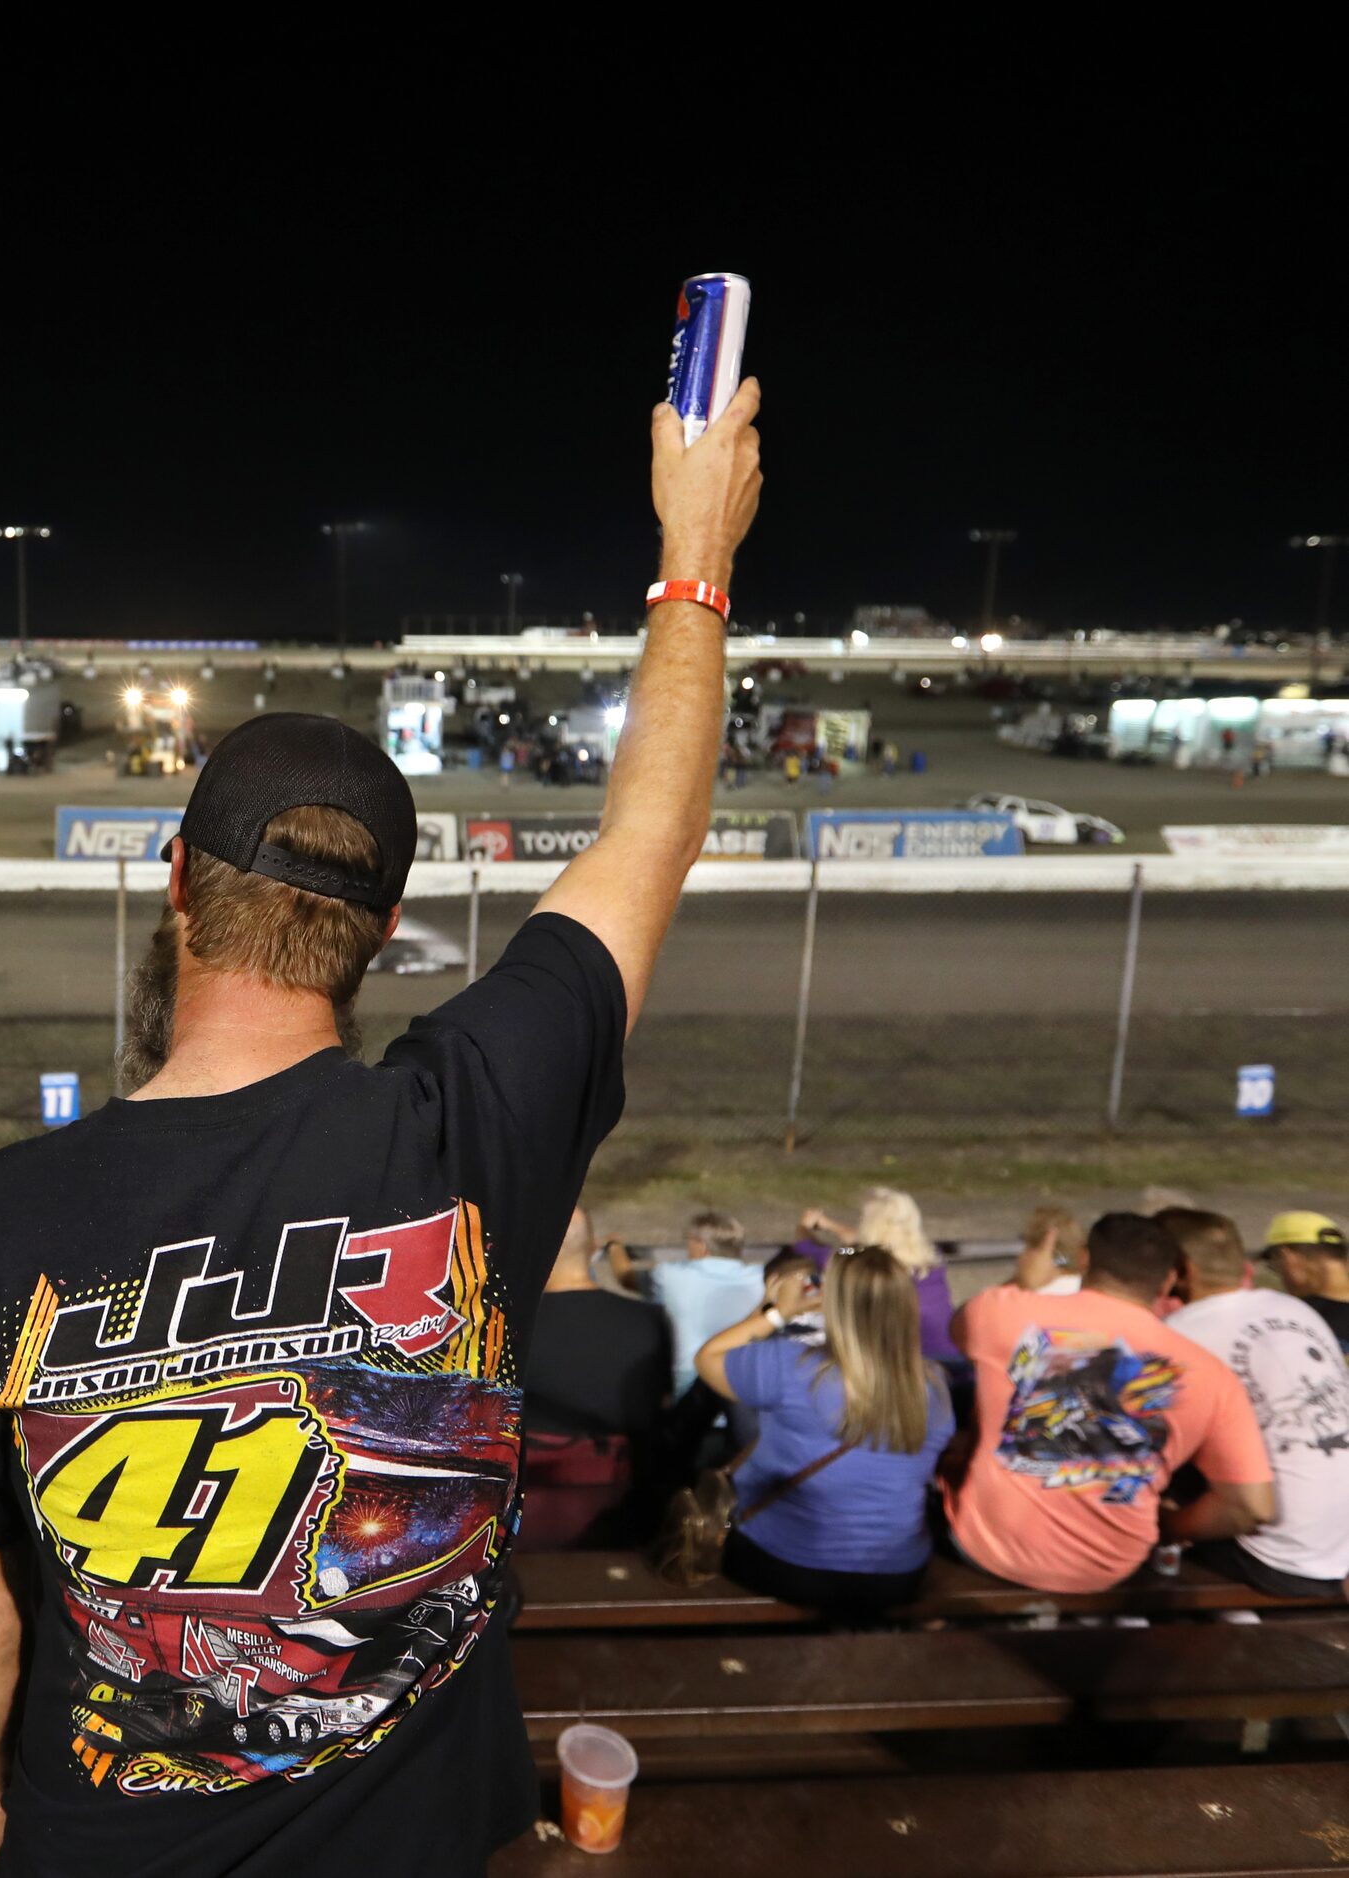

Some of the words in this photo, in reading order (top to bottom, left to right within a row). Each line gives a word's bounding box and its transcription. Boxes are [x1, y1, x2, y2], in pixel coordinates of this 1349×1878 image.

[65, 820, 158, 858] NOS
[819, 822, 901, 857] NOS
[904, 821, 1008, 839] ENERGY
[904, 841, 982, 857] DRINK
[41, 1206, 467, 1373] JJR
[27, 1361, 159, 1403] JASON
[163, 1326, 363, 1380] JOHNSON
[38, 1410, 315, 1588] 41
[226, 1627, 273, 1646] MESILLA
[244, 1645, 282, 1657] VALLEY
[252, 1655, 328, 1683] TRANSPORTATION
